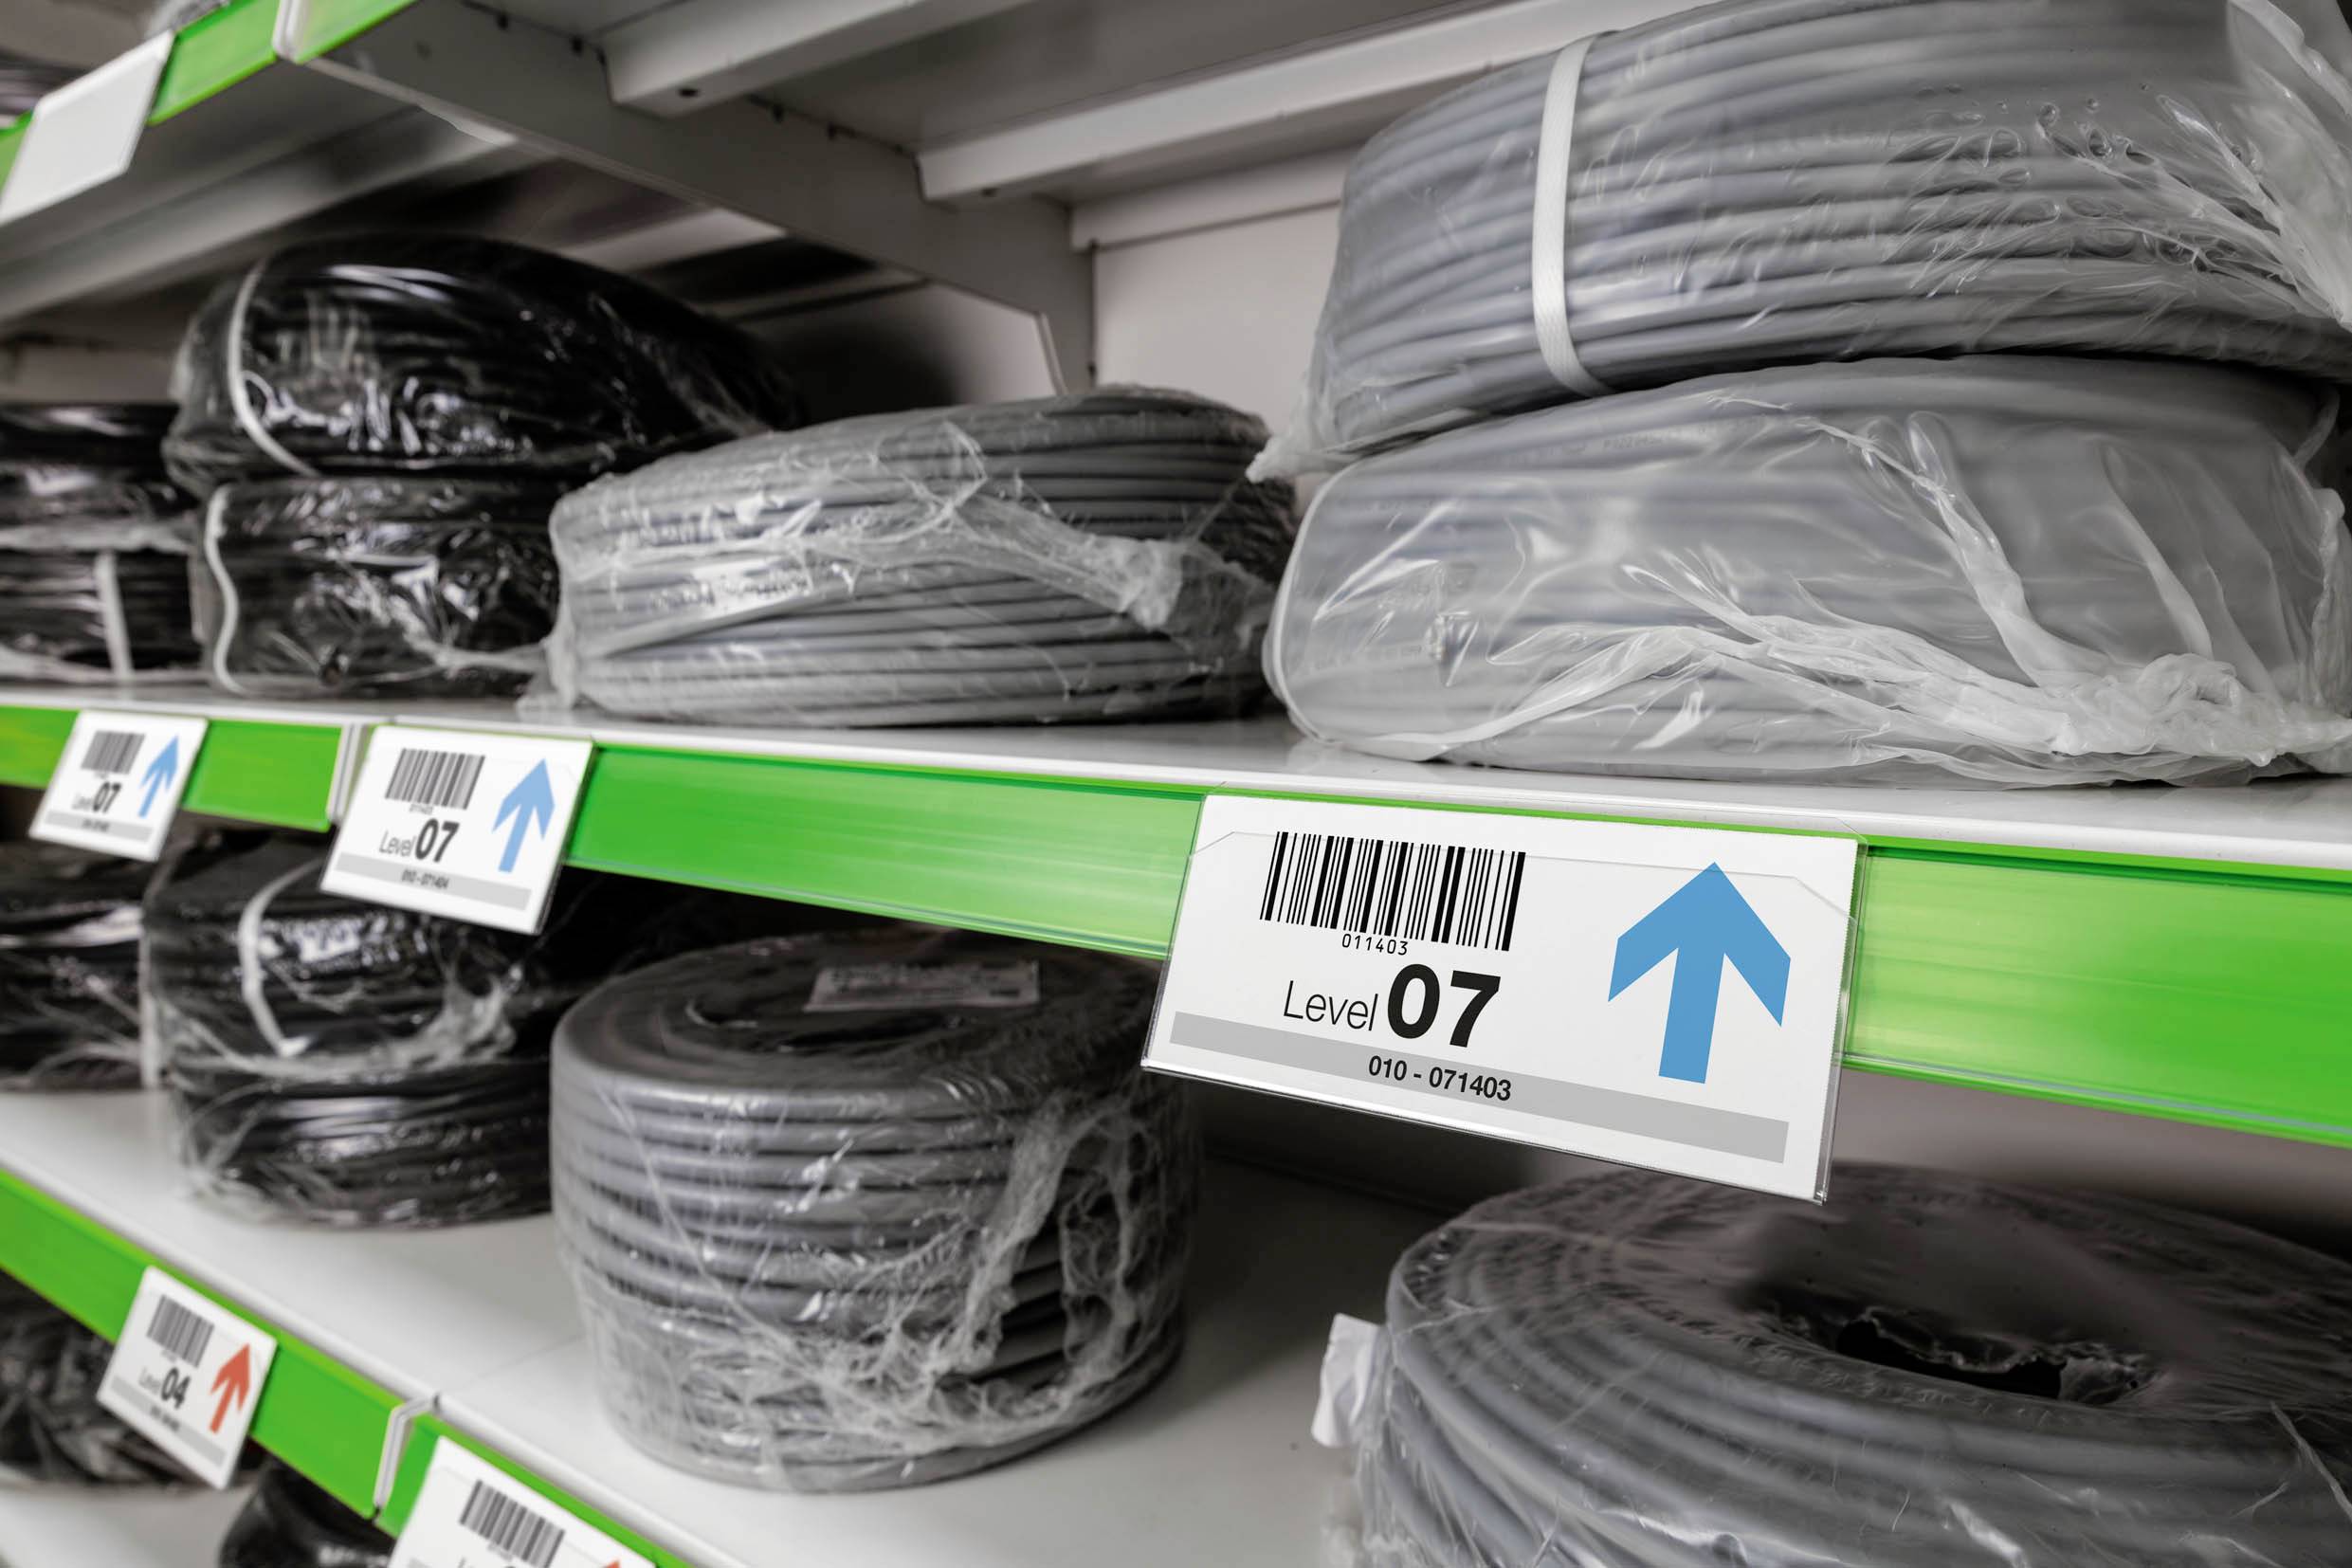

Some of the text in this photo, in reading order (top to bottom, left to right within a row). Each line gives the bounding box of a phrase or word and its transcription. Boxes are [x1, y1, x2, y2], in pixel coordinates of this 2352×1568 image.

[93, 782, 121, 813] 07
[378, 818, 460, 863] Level 07
[1341, 933, 1409, 956] 011403
[1283, 963, 1502, 1048] Level 07
[1368, 1055, 1408, 1082] 010
[1429, 1067, 1512, 1102] 071403
[160, 1366, 191, 1410] 04
